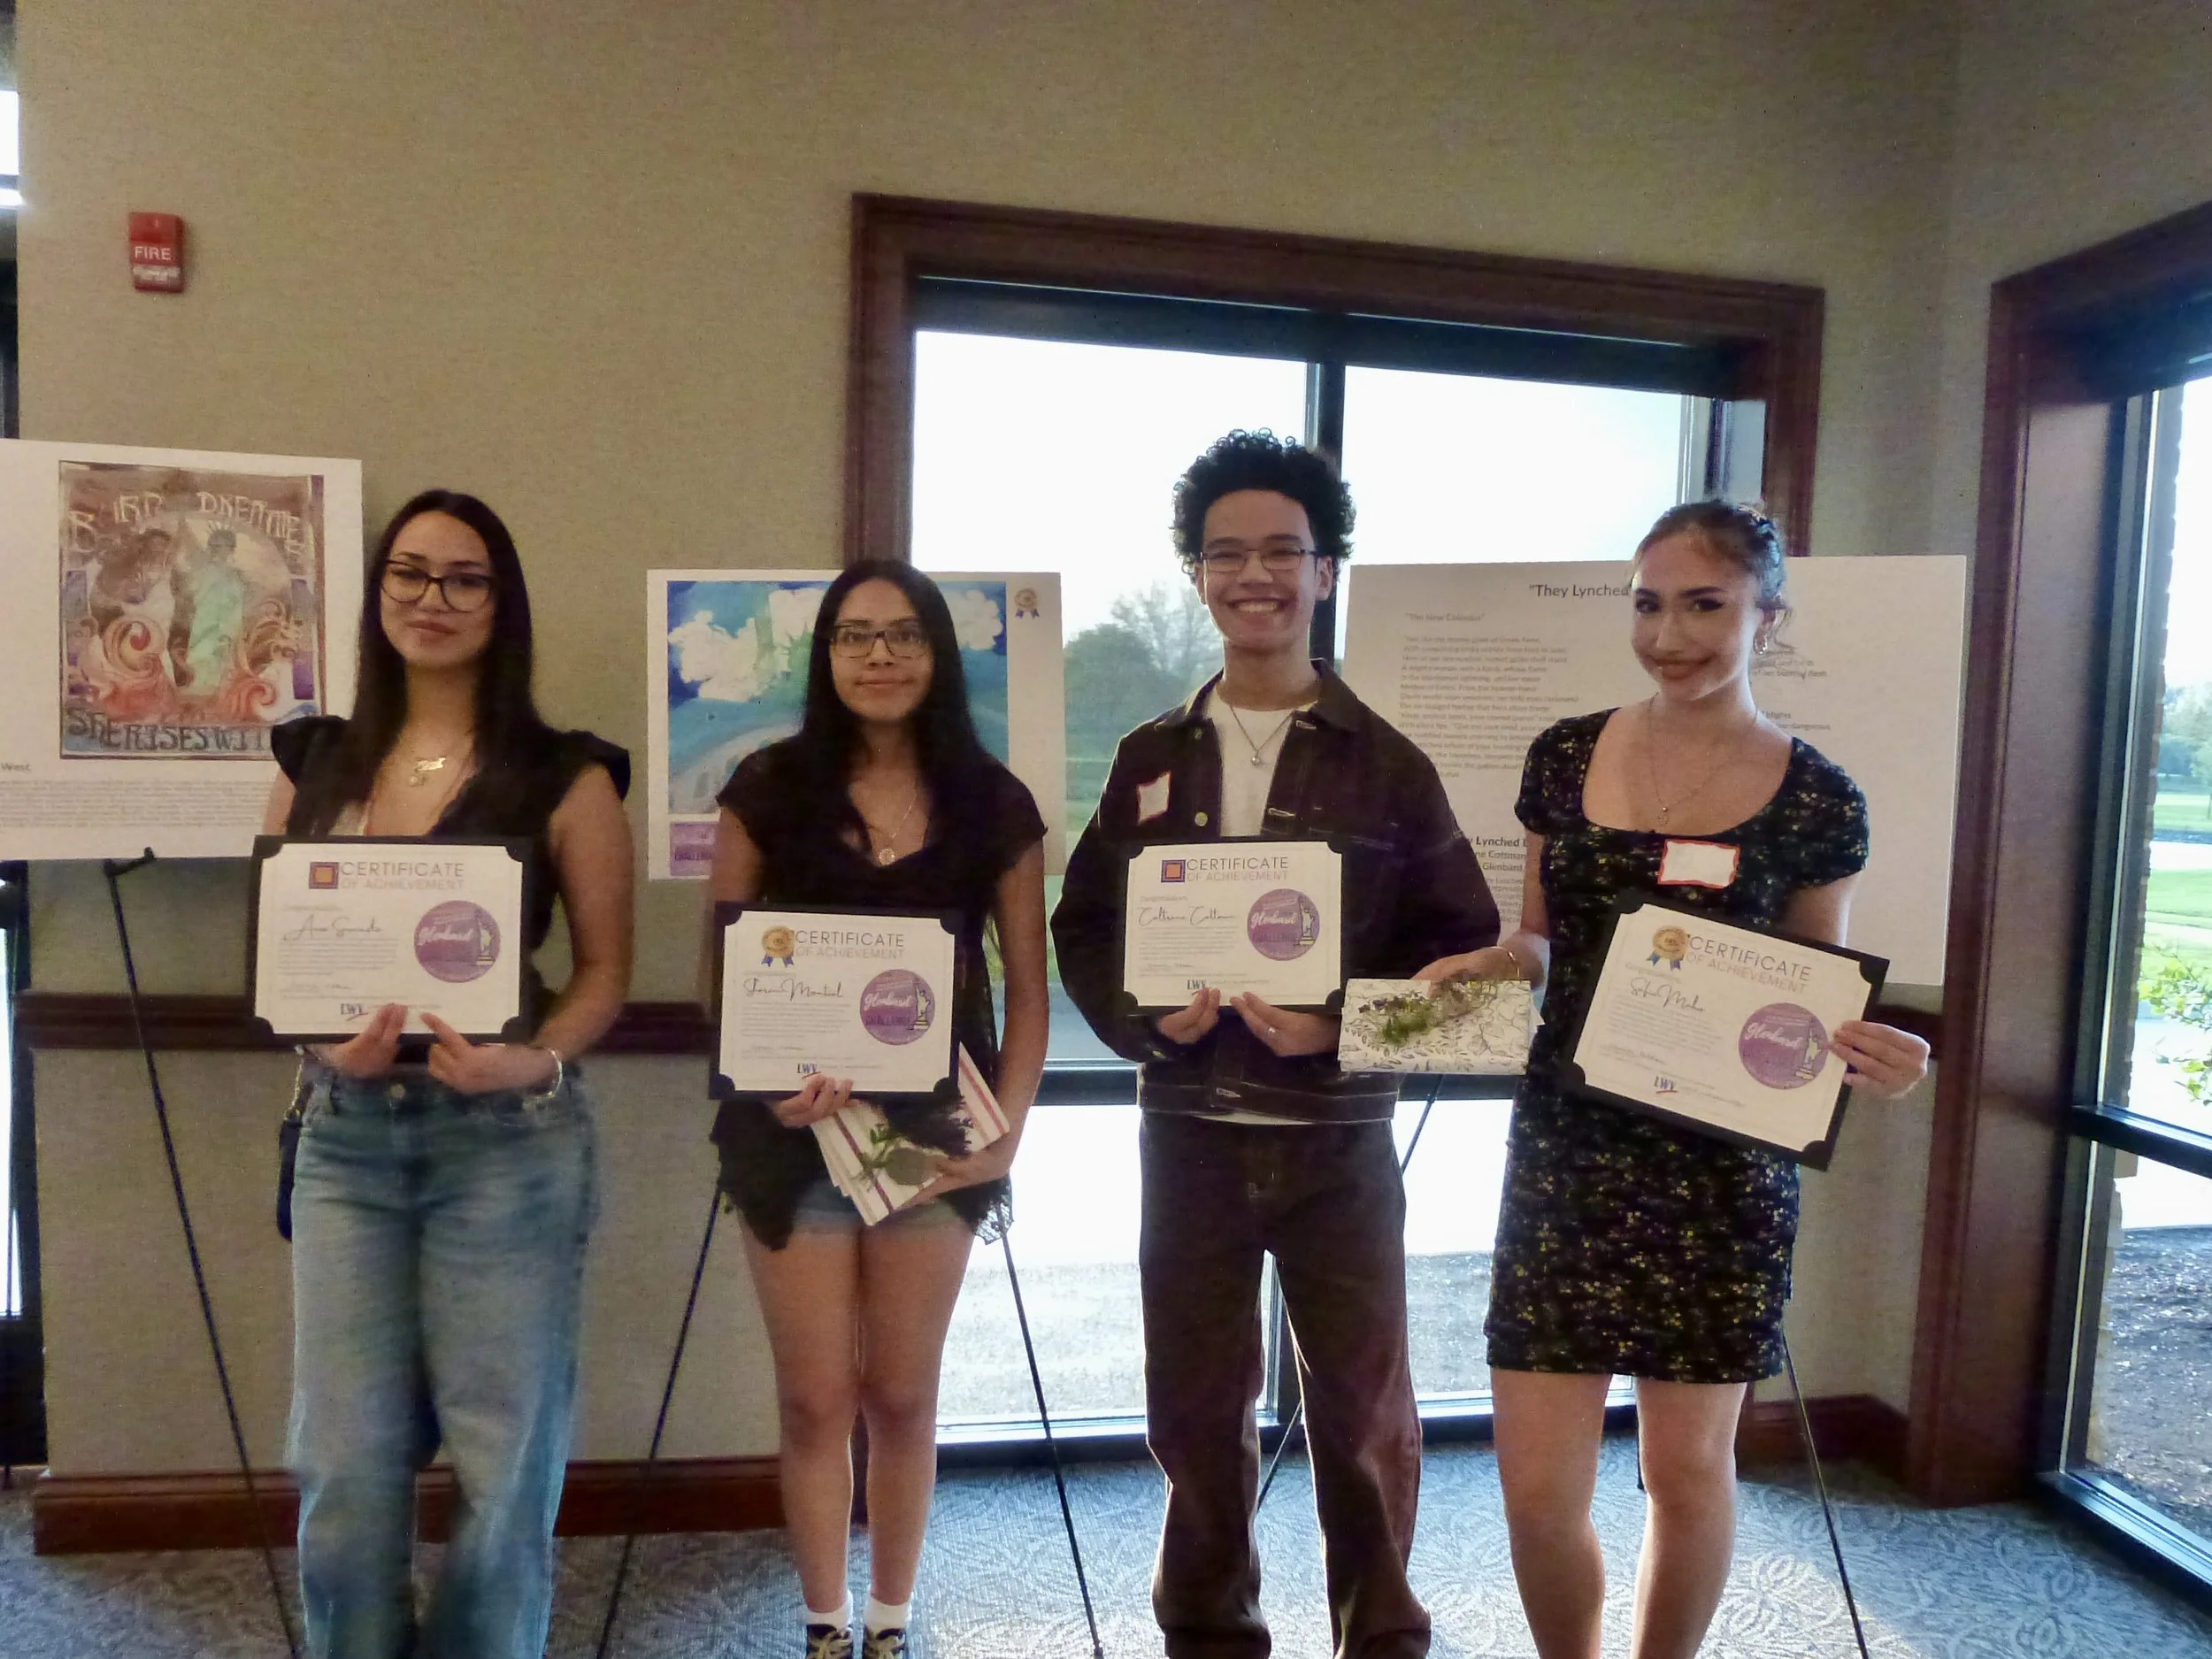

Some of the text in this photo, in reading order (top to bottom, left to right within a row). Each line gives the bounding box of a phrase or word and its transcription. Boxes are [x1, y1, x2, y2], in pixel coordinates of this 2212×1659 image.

[134, 246, 171, 260] FIRE
[1529, 584, 1569, 598] "They
[1476, 836, 1519, 847] Lynched
[341, 862, 465, 877] CERTIFICATE
[1187, 856, 1288, 871] CERTIFICATE
[1187, 870, 1287, 882] OF ACHIEVEMENT
[364, 879, 465, 890] ACHIEVEMENT
[796, 930, 904, 948] CERTIFICATE
[796, 947, 904, 959] OF ACHIEVEMENT
[1690, 936, 1811, 981] CERTIFICATE
[1686, 951, 1703, 963] OF
[1709, 957, 1808, 994] ACHIEVEMENT
